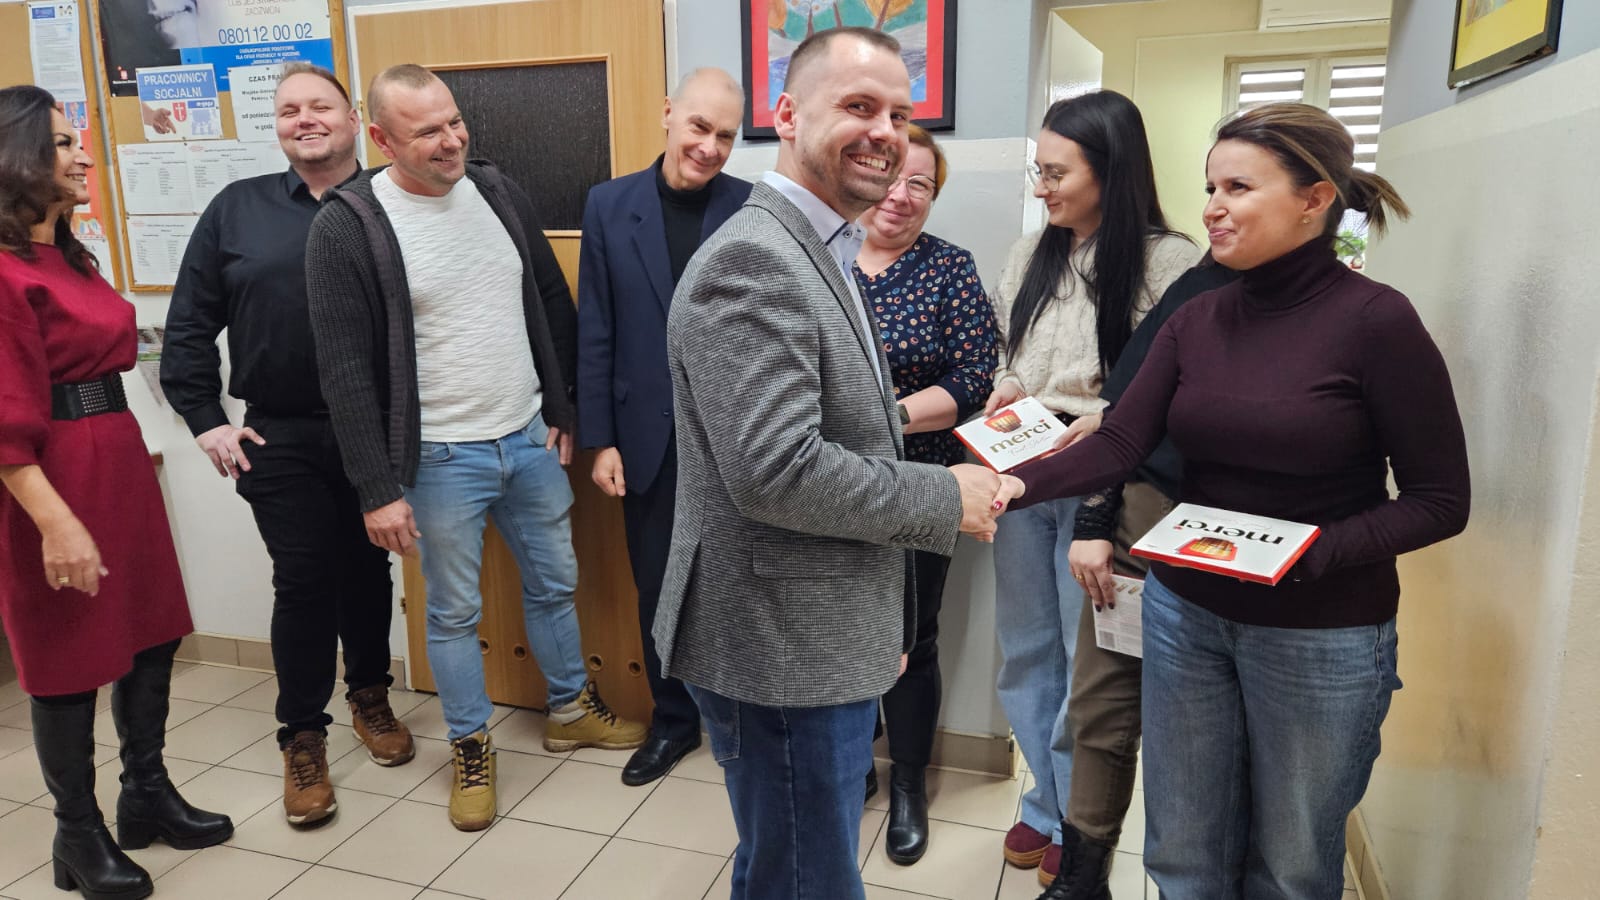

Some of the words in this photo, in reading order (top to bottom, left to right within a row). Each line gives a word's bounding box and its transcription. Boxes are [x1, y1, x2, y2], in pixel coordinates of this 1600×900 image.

[273, 24, 290, 41] 00
[295, 22, 313, 39] 02
[143, 72, 208, 86] PRACOWNICY
[154, 87, 202, 99] SOCJALNI
[990, 418, 1052, 453] merci
[1172, 519, 1285, 545] merci
